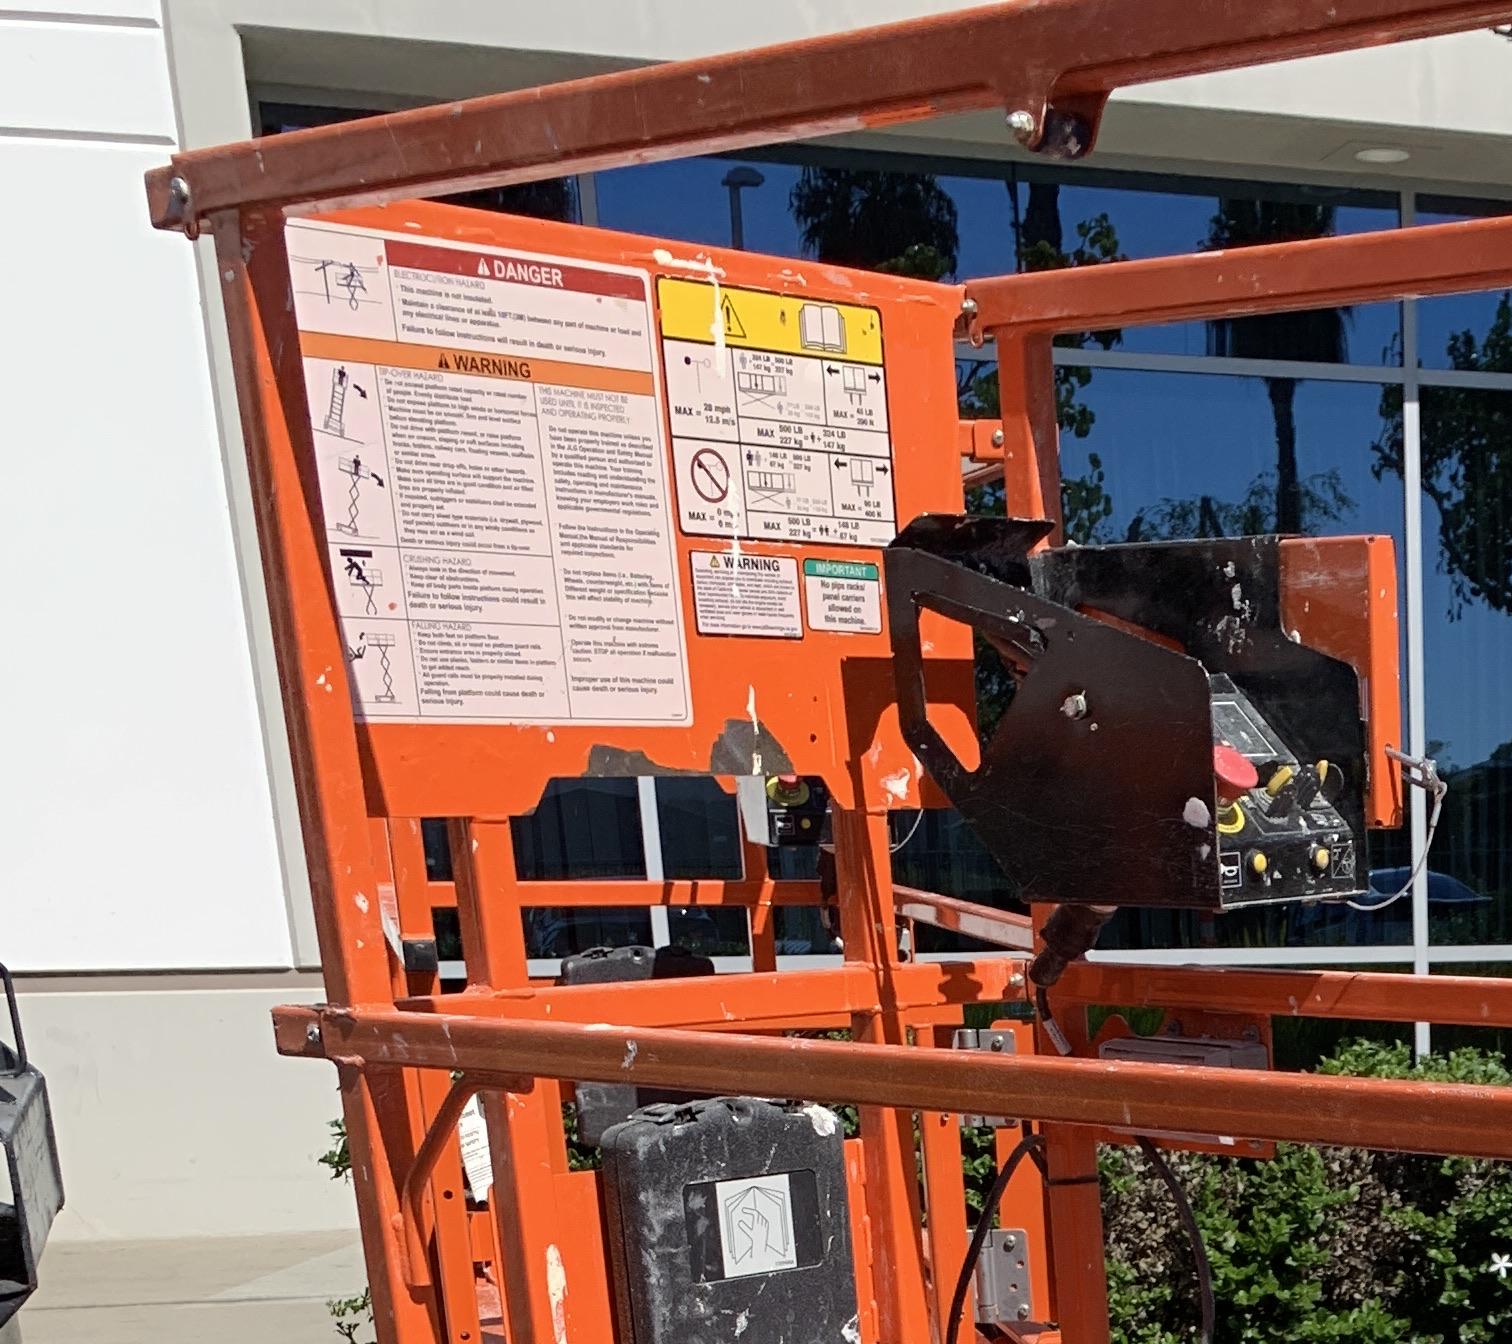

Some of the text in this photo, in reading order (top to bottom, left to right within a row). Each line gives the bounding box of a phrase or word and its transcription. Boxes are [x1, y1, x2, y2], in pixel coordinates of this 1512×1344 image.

[493, 259, 564, 288] DANGER
[453, 353, 532, 379] WARNING
[673, 404, 694, 416] MAX
[832, 409, 848, 419] MAX
[755, 426, 775, 438] MAX
[840, 502, 856, 511] MAX
[687, 510, 707, 521] MAX
[762, 520, 781, 531] MAX
[814, 562, 866, 577] IMPORTANT
[819, 579, 830, 589] No
[821, 592, 865, 603] panel carriers
[826, 603, 862, 614] allowed on
[823, 614, 837, 623] this
